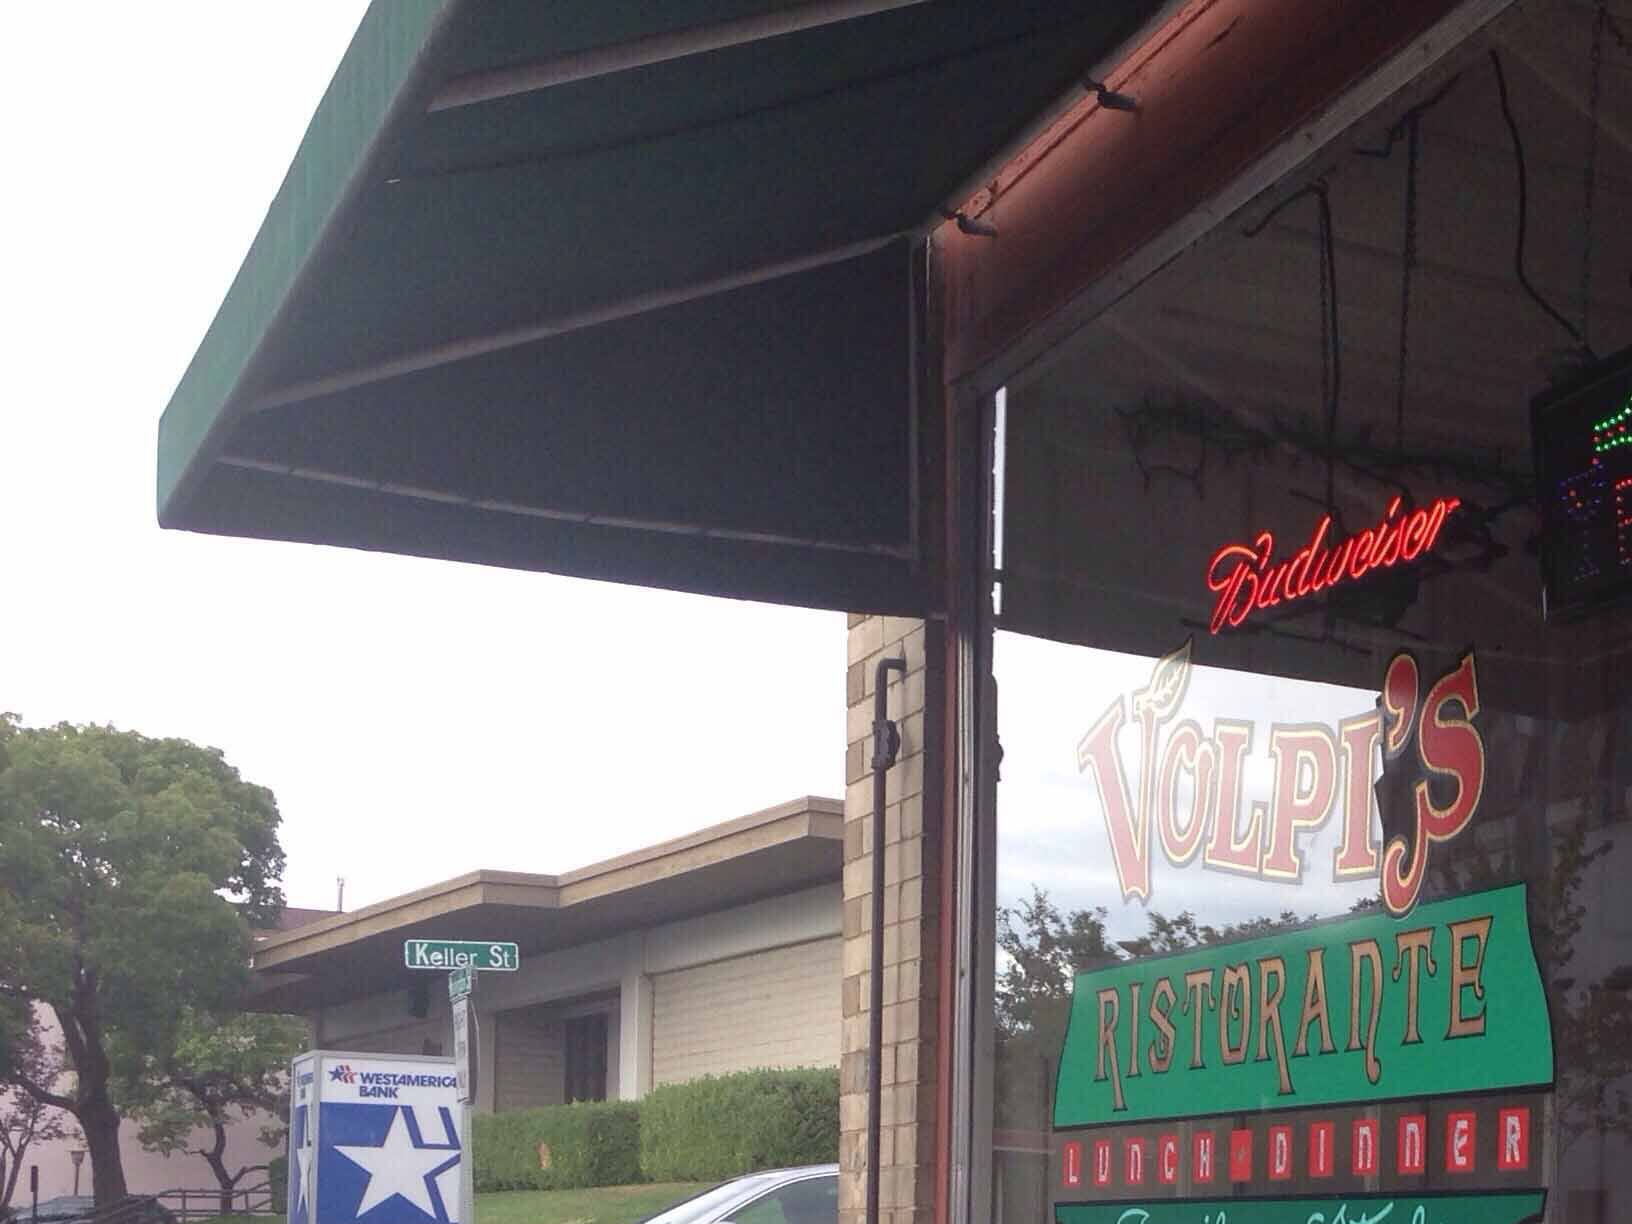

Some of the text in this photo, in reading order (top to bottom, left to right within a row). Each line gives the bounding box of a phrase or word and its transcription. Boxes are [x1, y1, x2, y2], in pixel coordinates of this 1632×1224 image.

[1207, 497, 1462, 636] Budweiser
[1077, 642, 1487, 919] VOLPI'S
[415, 943, 511, 968] Keller St
[1093, 914, 1495, 1112] RISTORANTE
[359, 1072, 457, 1091] WESTAMERICA
[359, 1086, 399, 1099] BANK
[1067, 1114, 1521, 1185] LUNCH DINNER
